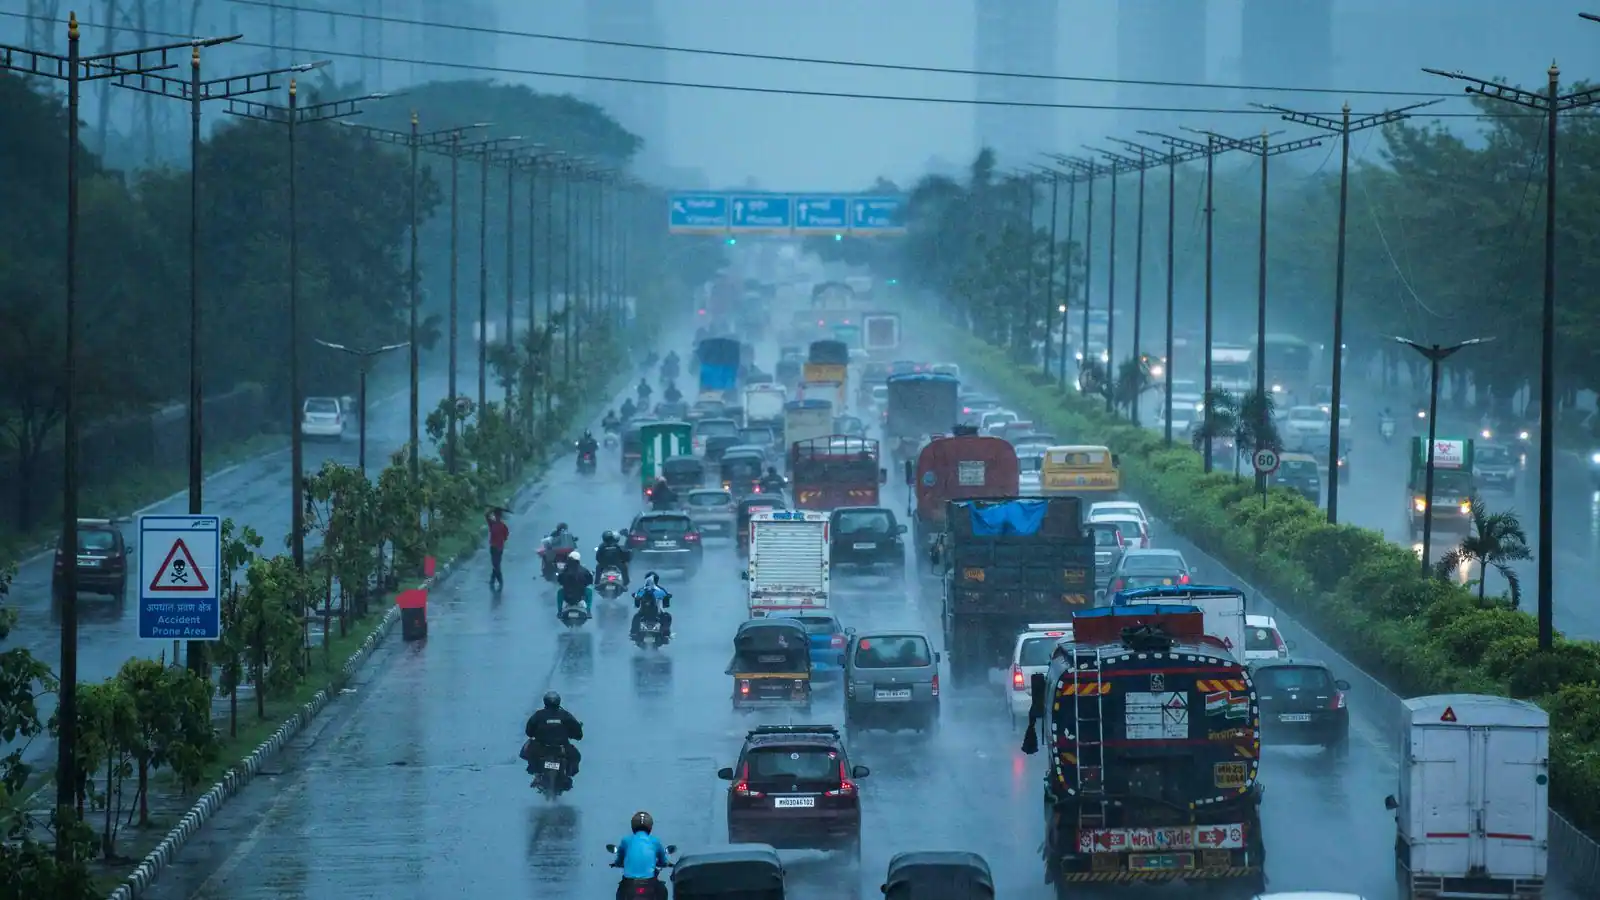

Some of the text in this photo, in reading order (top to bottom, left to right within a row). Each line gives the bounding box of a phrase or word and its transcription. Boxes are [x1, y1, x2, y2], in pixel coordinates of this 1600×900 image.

[1258, 454, 1274, 466] 60
[157, 615, 201, 624] Accident
[152, 626, 206, 636] Prone Area
